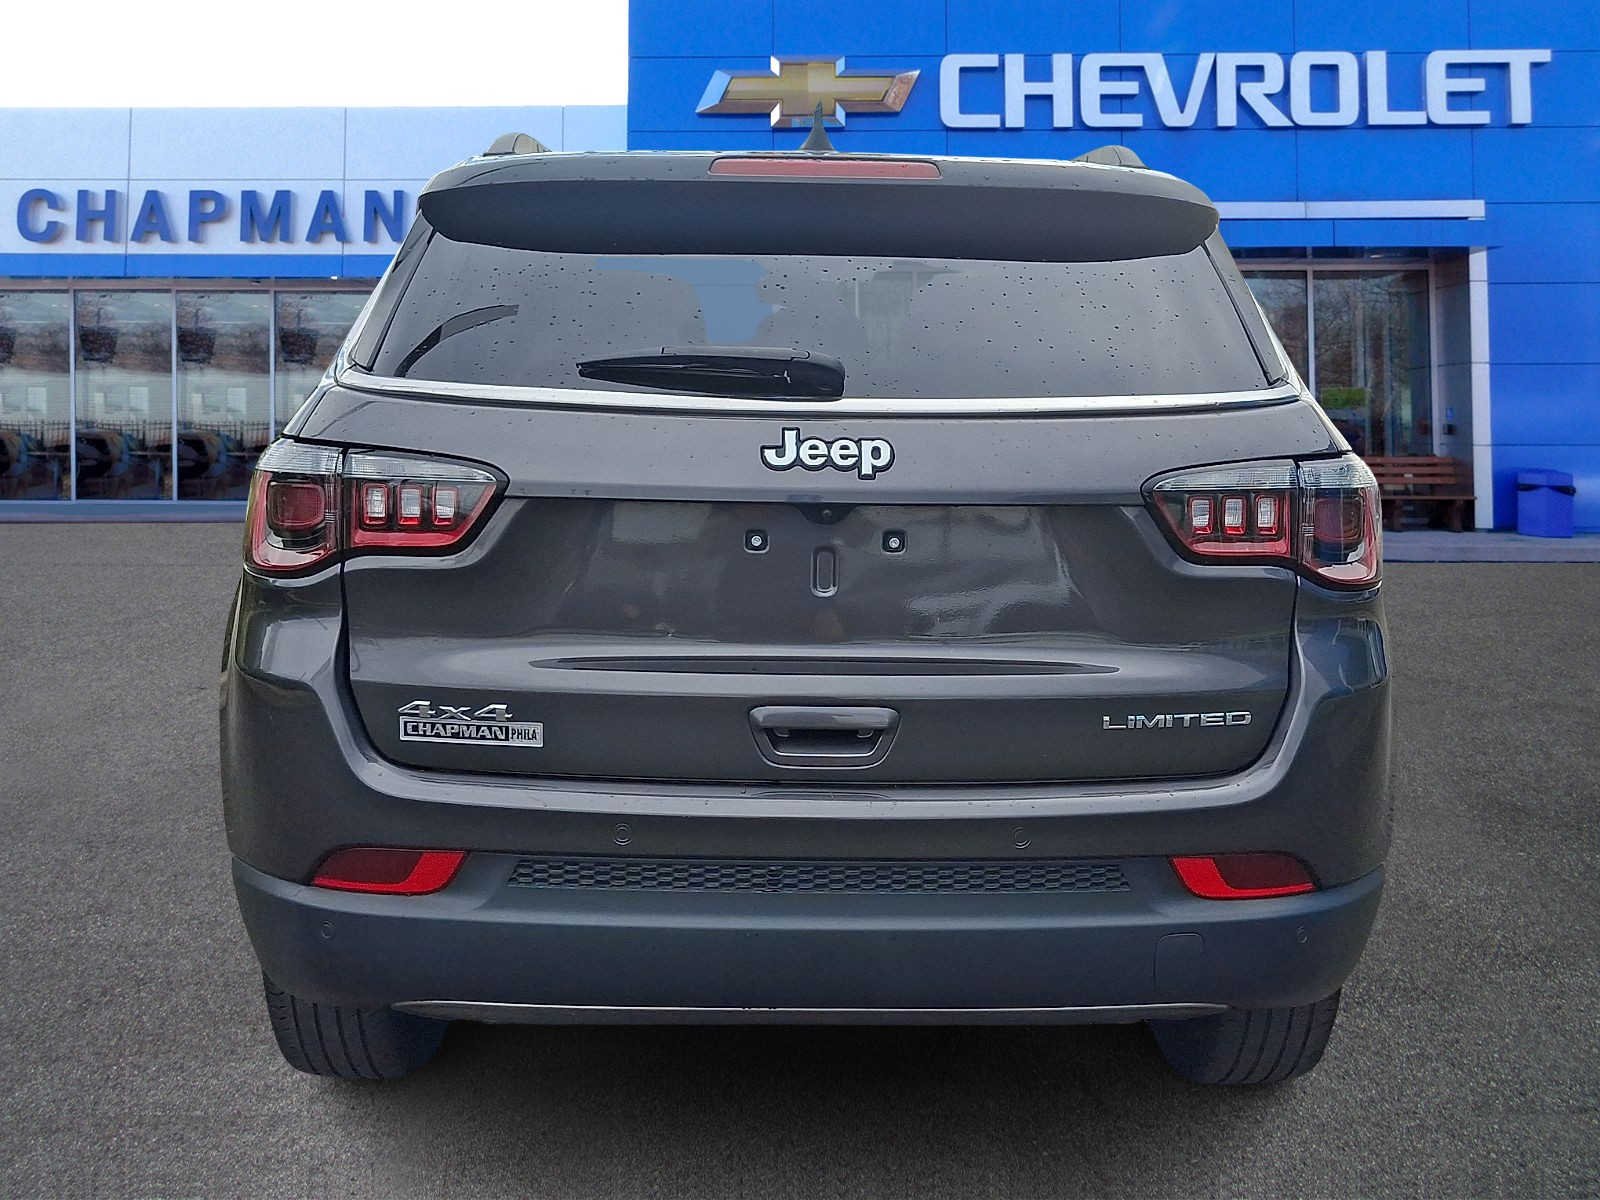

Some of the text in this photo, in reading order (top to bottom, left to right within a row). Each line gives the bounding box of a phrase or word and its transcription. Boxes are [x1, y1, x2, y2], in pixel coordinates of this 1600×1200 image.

[938, 49, 1552, 129] CHEVROLET
[16, 187, 406, 244] CHAPMAN
[761, 428, 895, 479] Jeep
[398, 700, 513, 721] 4x4
[1102, 710, 1252, 730] LIMITED
[405, 721, 539, 742] CHAPMAN PHILA
